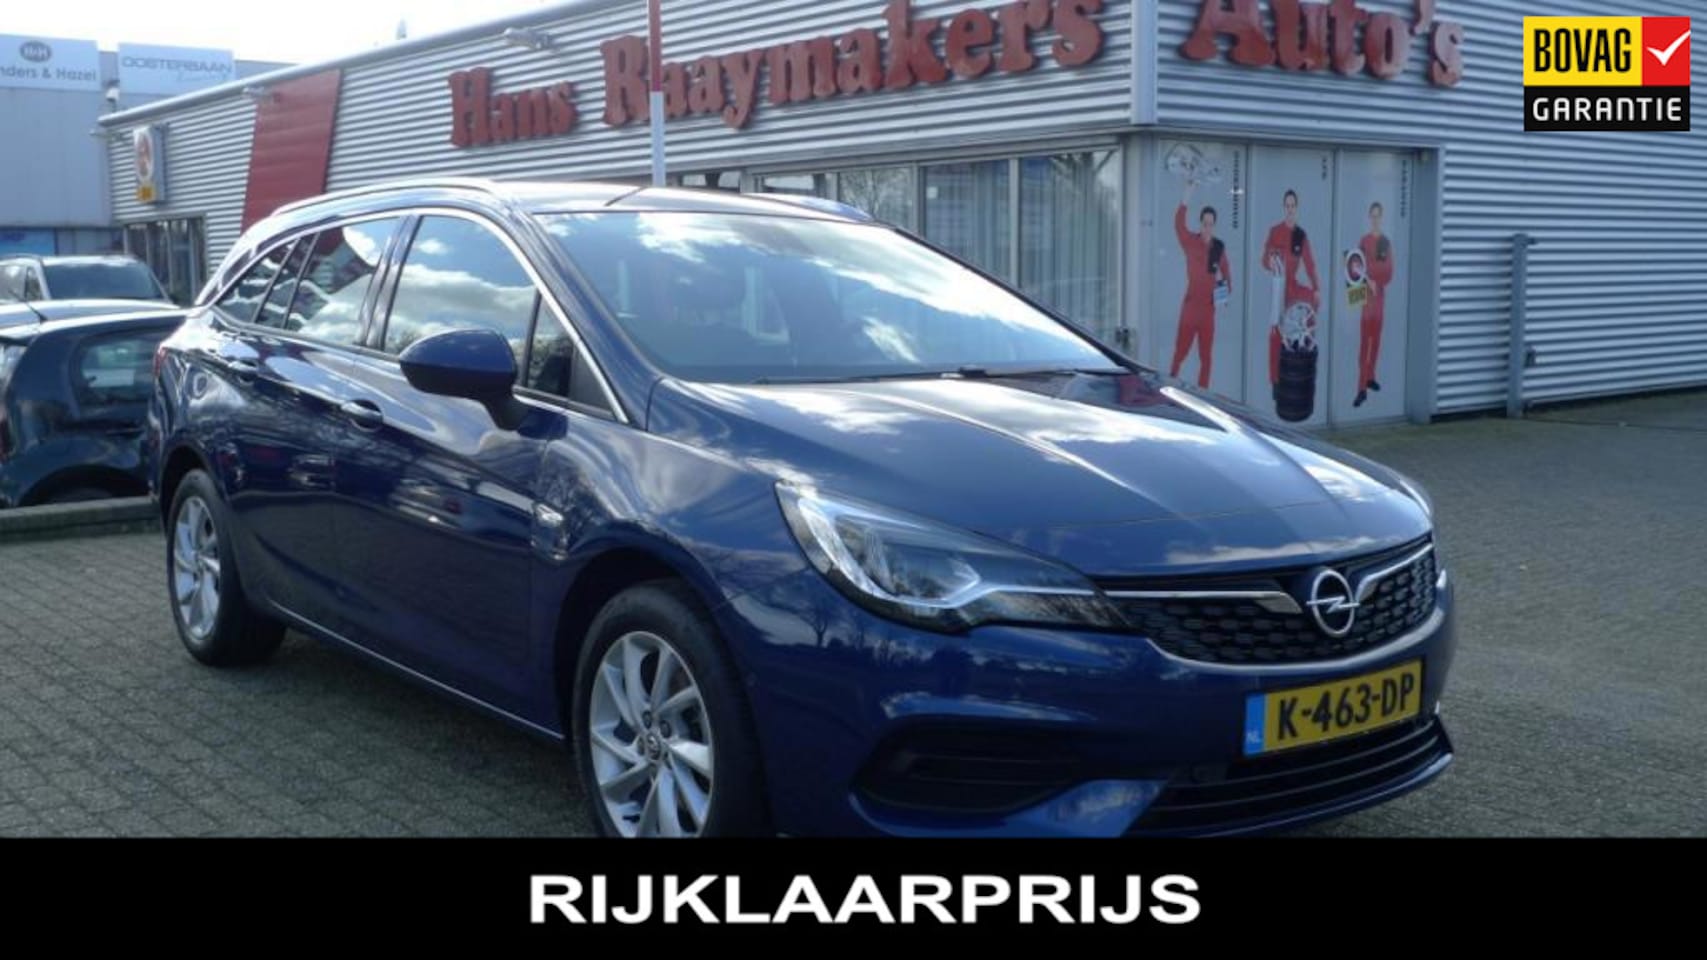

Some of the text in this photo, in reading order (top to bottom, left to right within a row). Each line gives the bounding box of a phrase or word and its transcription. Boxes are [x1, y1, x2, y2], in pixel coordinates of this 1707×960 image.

[42, 66, 51, 79] &
[56, 66, 97, 81] Hazel
[121, 56, 232, 73] OOSTERBAAN
[448, 0, 1464, 147] Hans Raaymakers Auto's
[1277, 673, 1415, 741] K-463-DP
